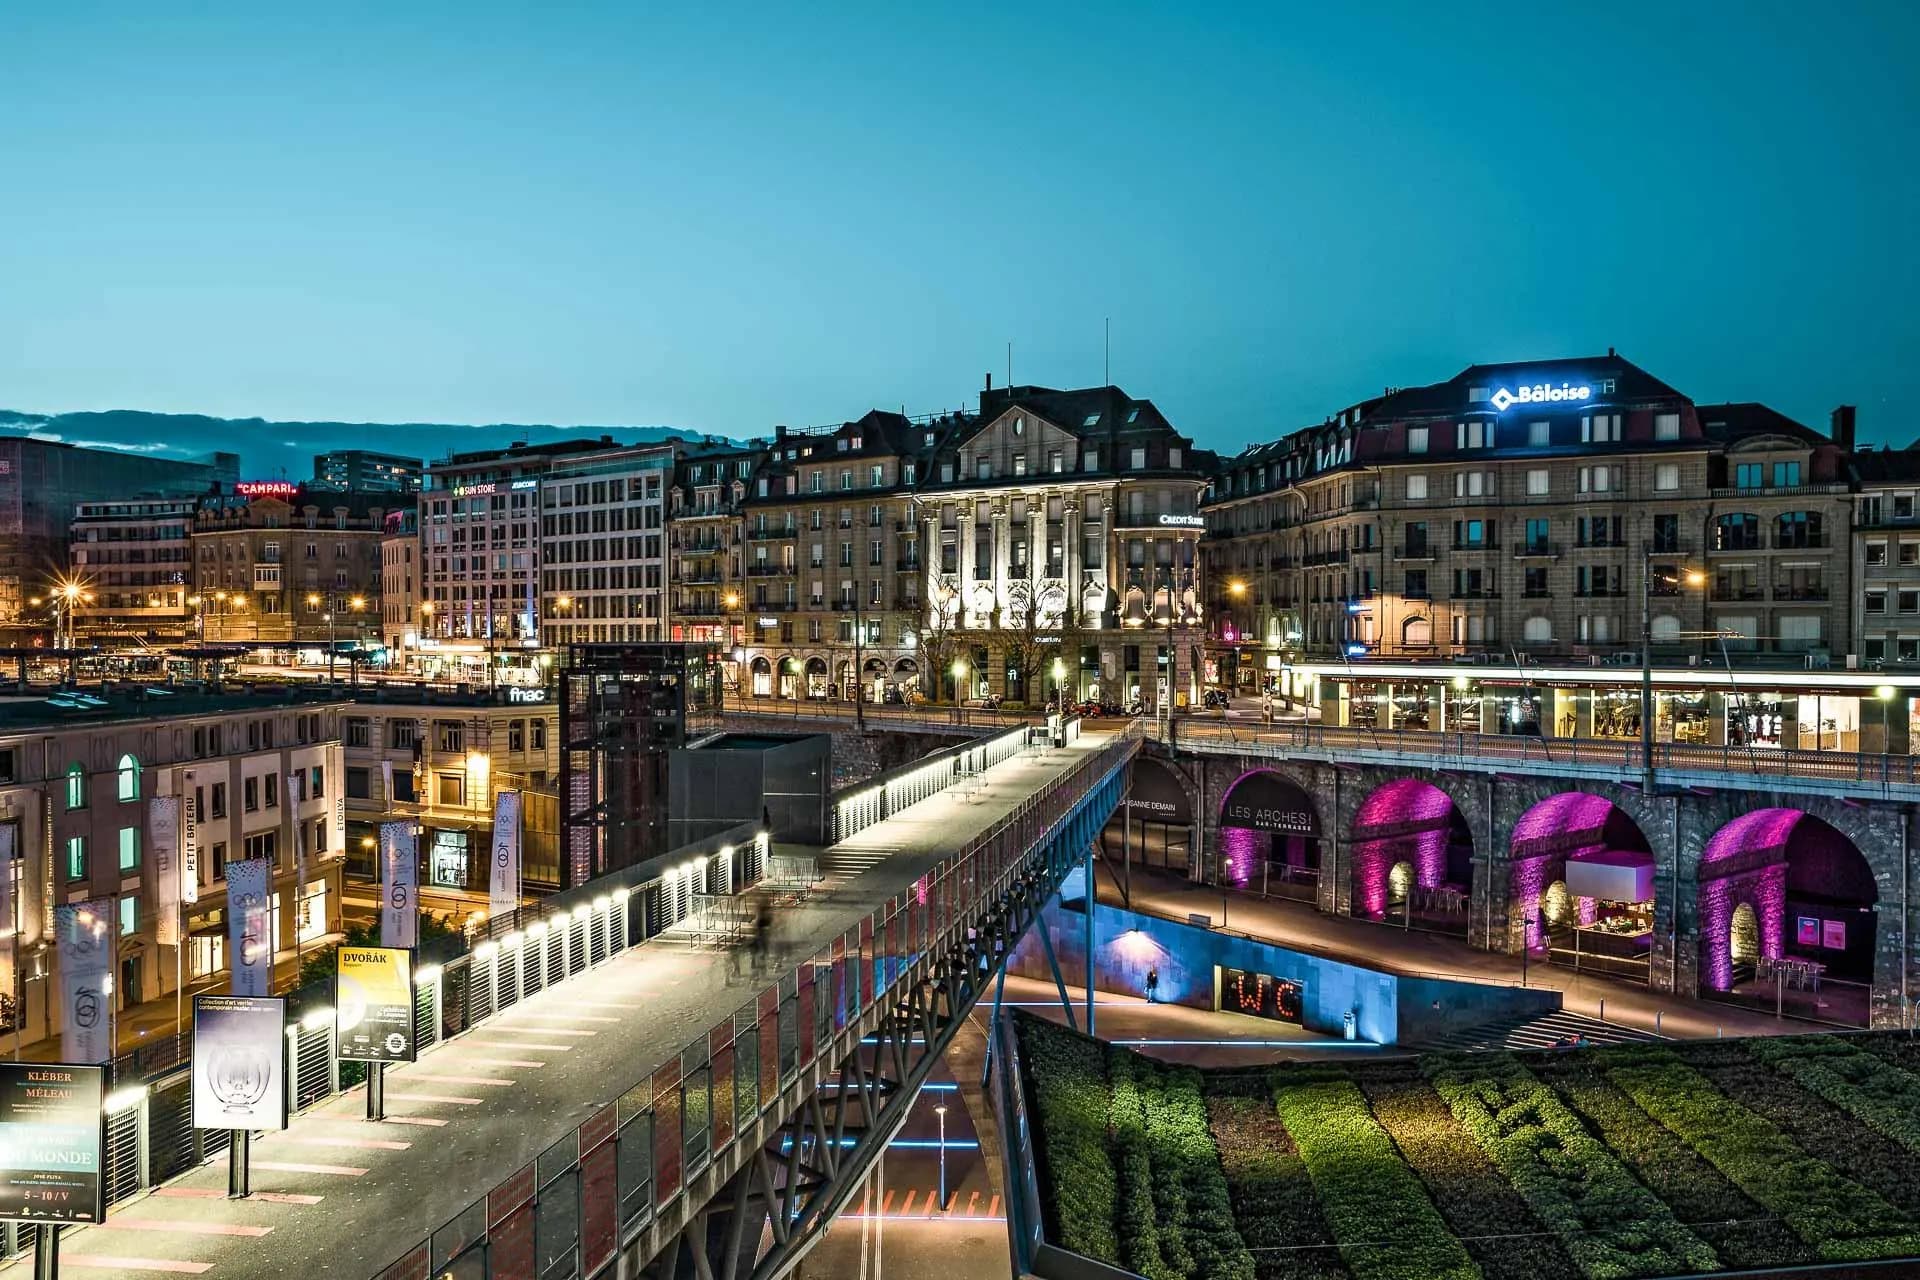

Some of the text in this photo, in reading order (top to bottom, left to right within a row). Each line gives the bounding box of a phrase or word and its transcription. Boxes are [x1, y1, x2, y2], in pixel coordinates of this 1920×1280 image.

[1518, 383, 1590, 402] Bâloise
[242, 483, 291, 494] CAMPARI
[465, 483, 496, 496] SUN STORE
[510, 687, 545, 702] fnac
[1151, 802, 1176, 811] DEMAIN
[1229, 805, 1251, 819] LES
[186, 797, 196, 871] PETIT BATEAU
[344, 951, 387, 963] DVOŘÁK
[198, 998, 225, 1006] Collection
[28, 1070, 72, 1082] KLÉBER
[26, 1087, 72, 1099] MÉLEAU
[31, 1150, 92, 1165] MONDE
[24, 1190, 31, 1200] 5
[41, 1191, 53, 1201] 10
[61, 1192, 70, 1201] V
